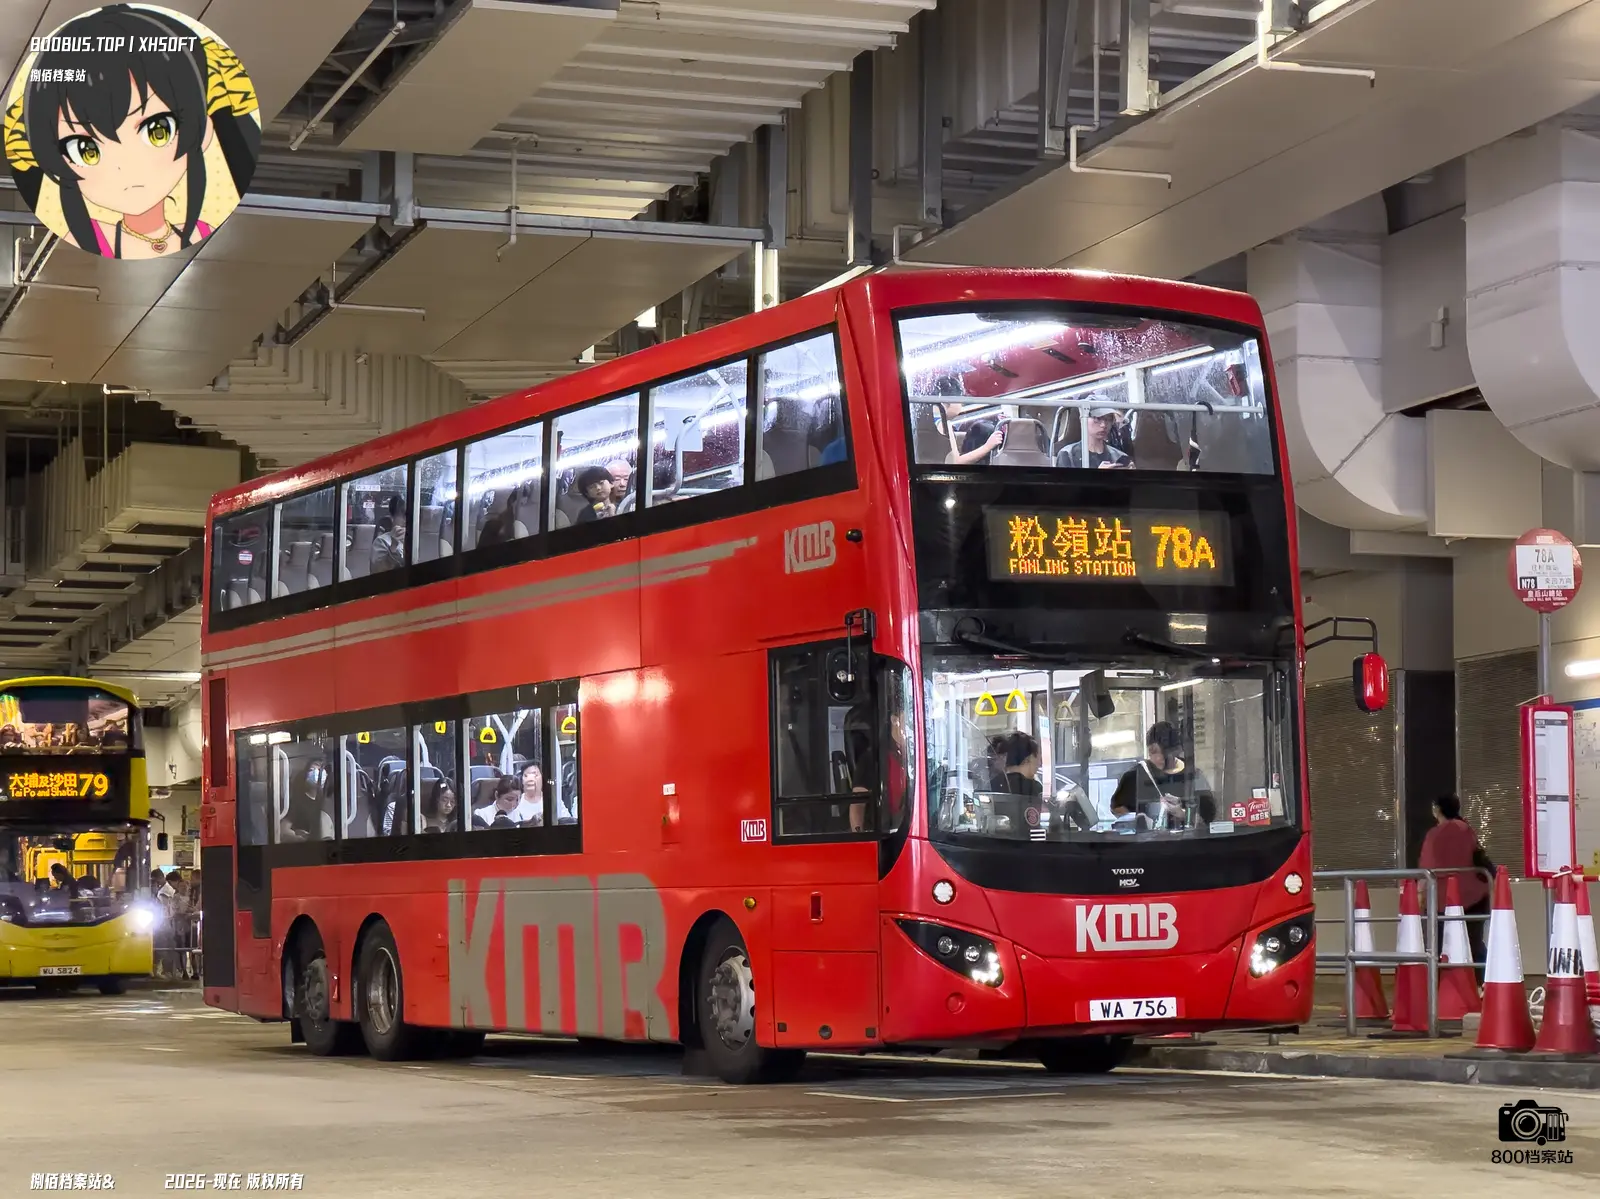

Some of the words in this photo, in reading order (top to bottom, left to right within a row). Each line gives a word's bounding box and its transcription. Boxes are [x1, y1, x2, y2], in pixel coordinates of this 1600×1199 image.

[784, 520, 837, 575] KMB
[1008, 515, 1132, 559] 粉嶺站
[1151, 526, 1216, 569] 78A
[1009, 558, 1070, 575] FANLING
[1074, 560, 1137, 576] STATION
[1534, 548, 1555, 563] 78A
[9, 787, 23, 797] Tai
[23, 787, 36, 797] Po
[79, 773, 109, 797] 79
[742, 820, 766, 841] KMB
[1075, 903, 1179, 953] KMB
[447, 872, 670, 1042] KMB
[1100, 1002, 1124, 1018] WA
[1132, 1000, 1167, 1017] 756
